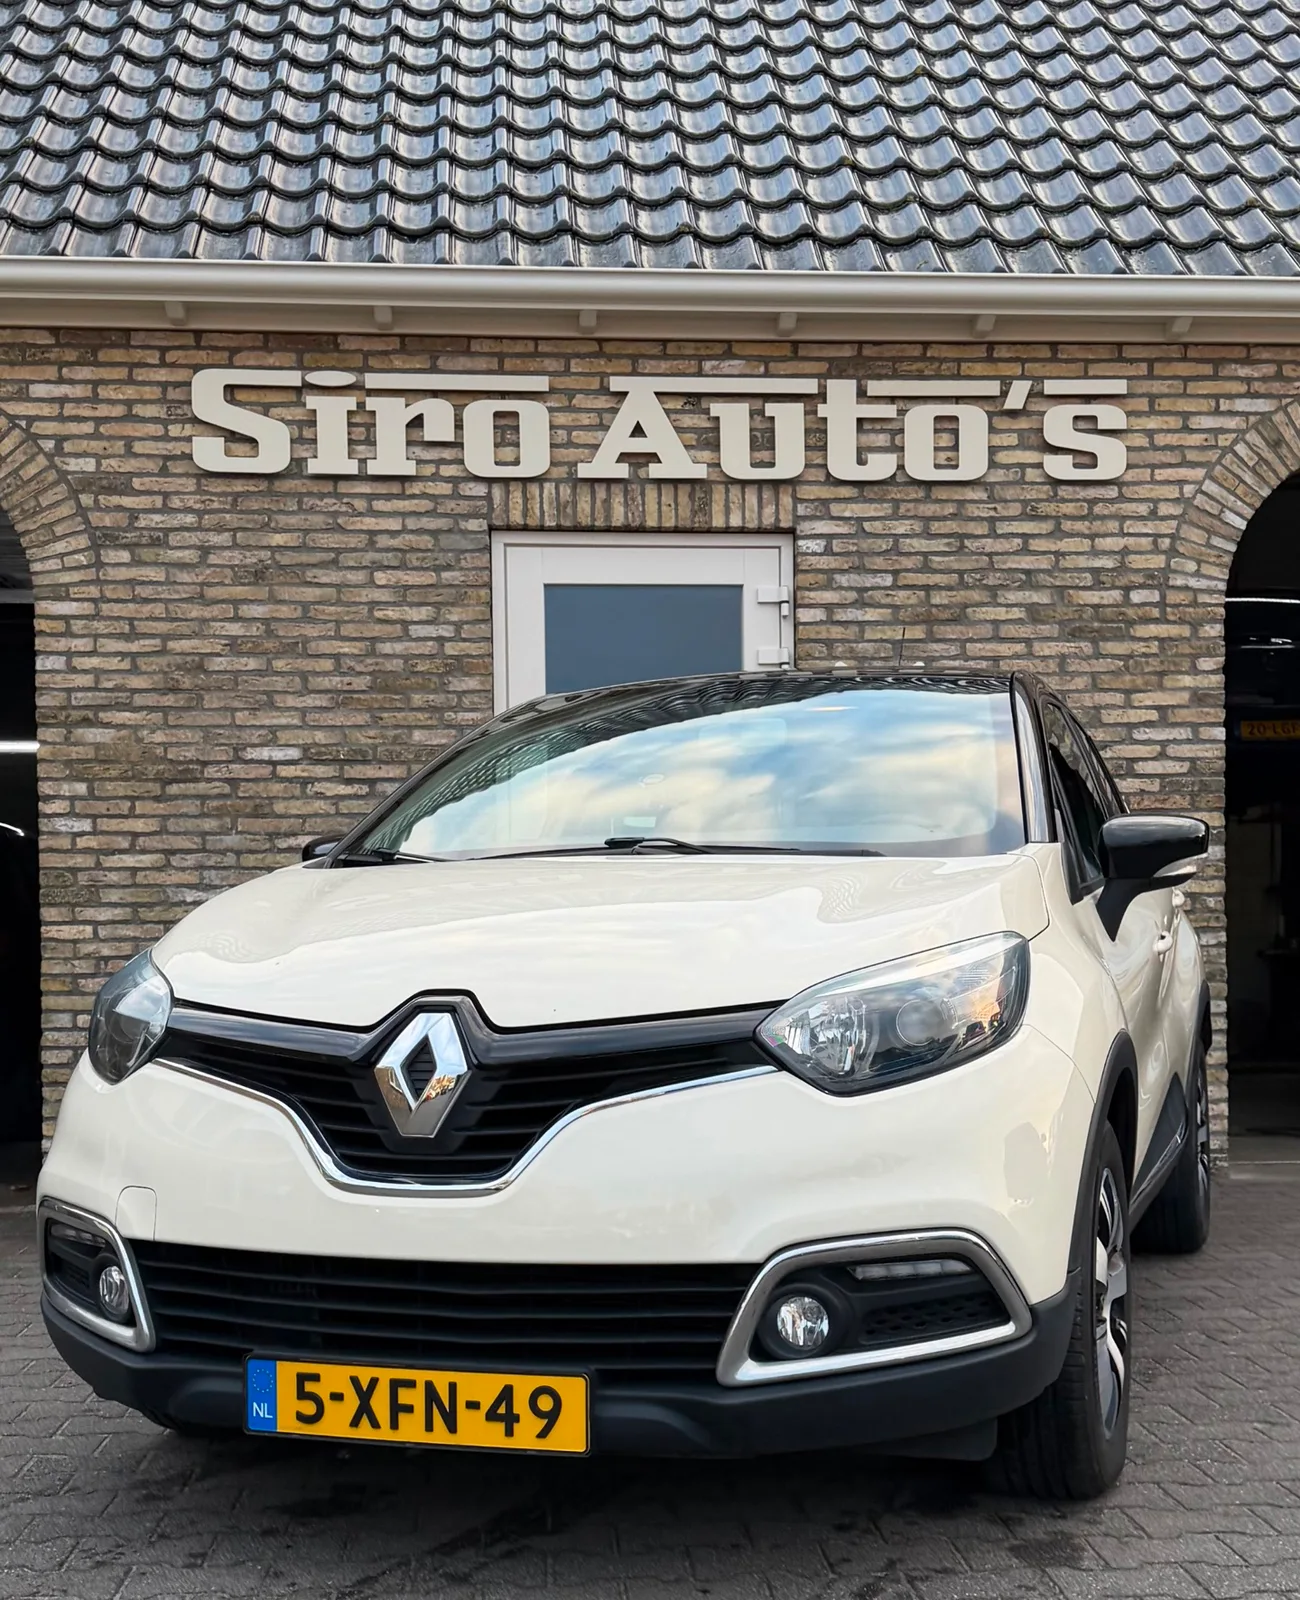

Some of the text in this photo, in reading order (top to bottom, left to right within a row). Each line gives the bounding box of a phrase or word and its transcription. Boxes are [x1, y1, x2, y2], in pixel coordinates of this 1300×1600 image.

[191, 368, 1128, 481] Siro Auto's
[252, 1371, 563, 1439] NL 5-XFN-49
